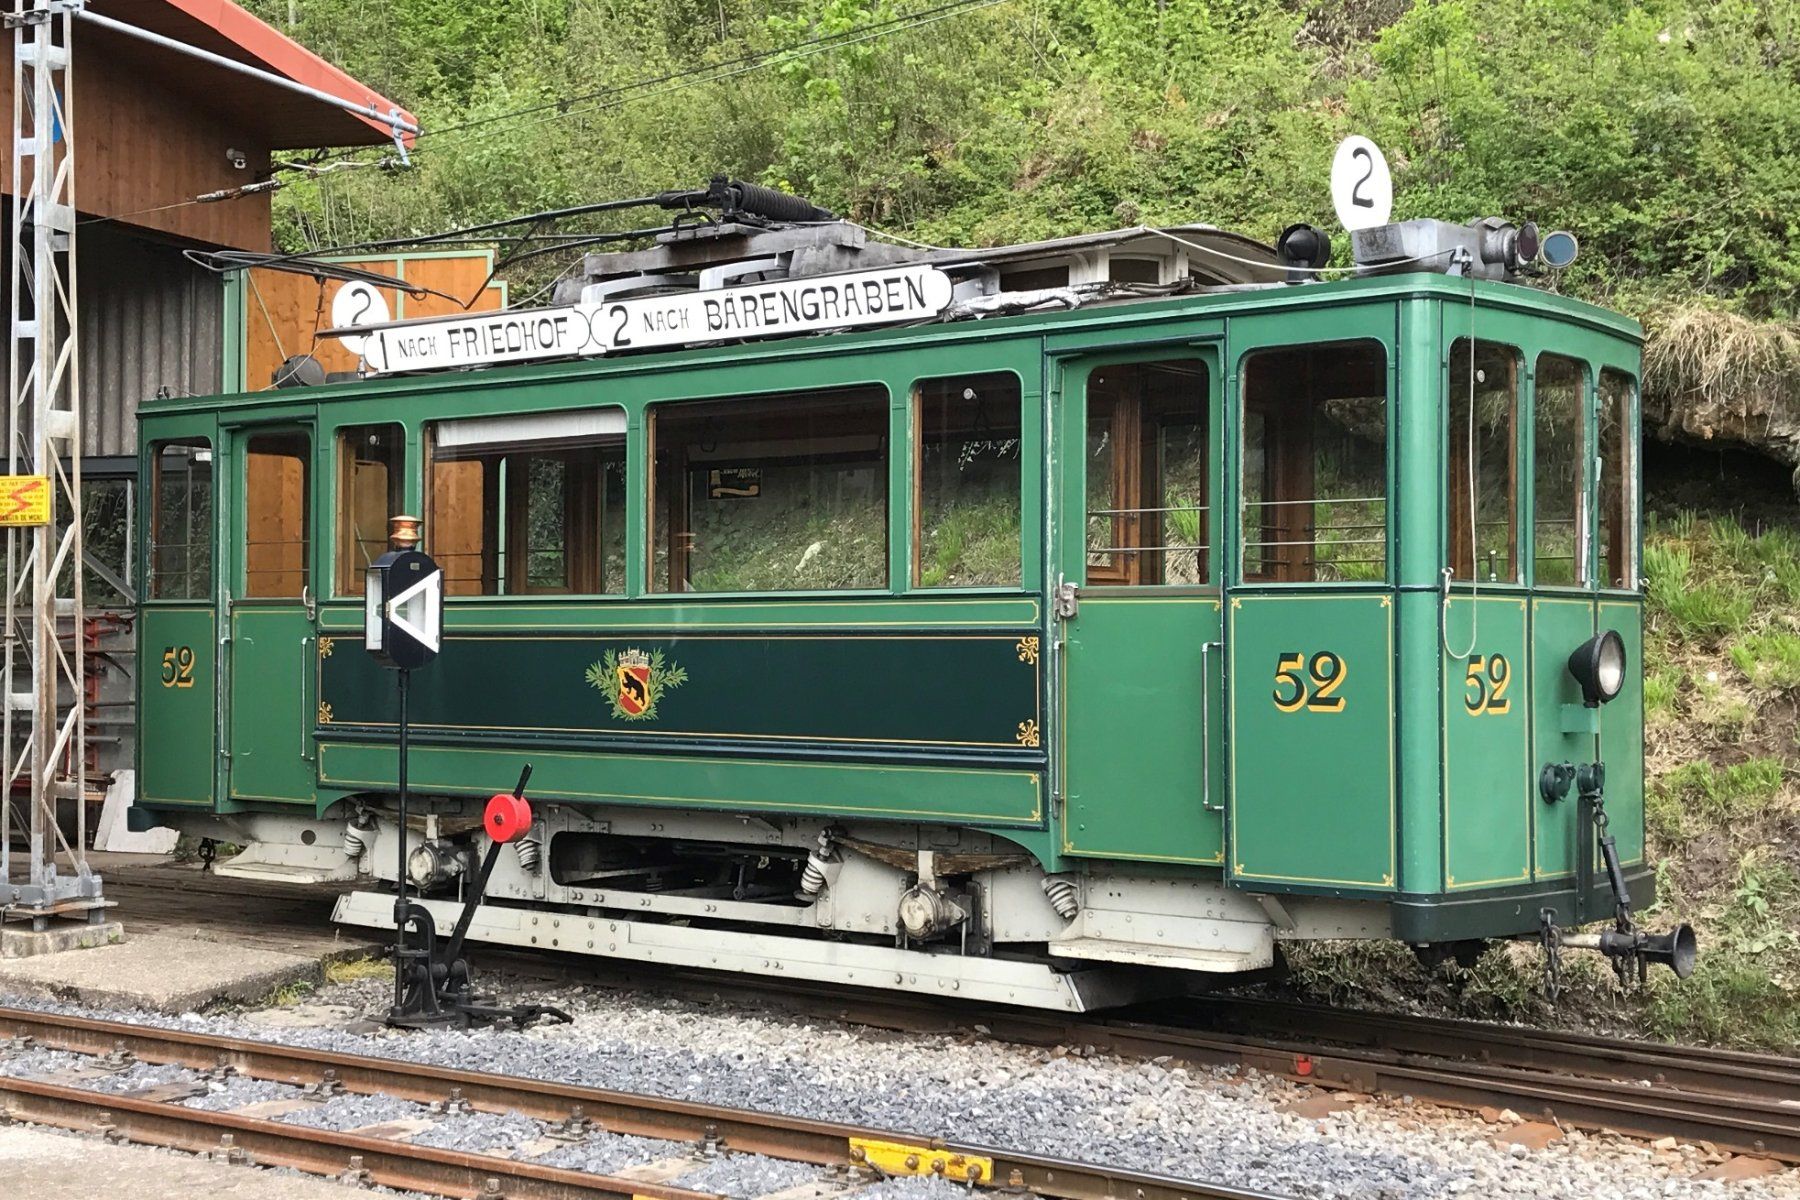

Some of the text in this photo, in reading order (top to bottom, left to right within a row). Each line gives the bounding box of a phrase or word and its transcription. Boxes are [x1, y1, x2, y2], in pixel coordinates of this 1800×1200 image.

[1352, 147, 1374, 208] 2
[351, 287, 371, 327] 2
[609, 274, 926, 347] 2 NACH BÄRENGRABEN
[379, 317, 568, 370] 1 NACH FRIEDHOF
[161, 646, 195, 688] 52
[1273, 650, 1347, 712] 52
[1464, 652, 1511, 716] 52
